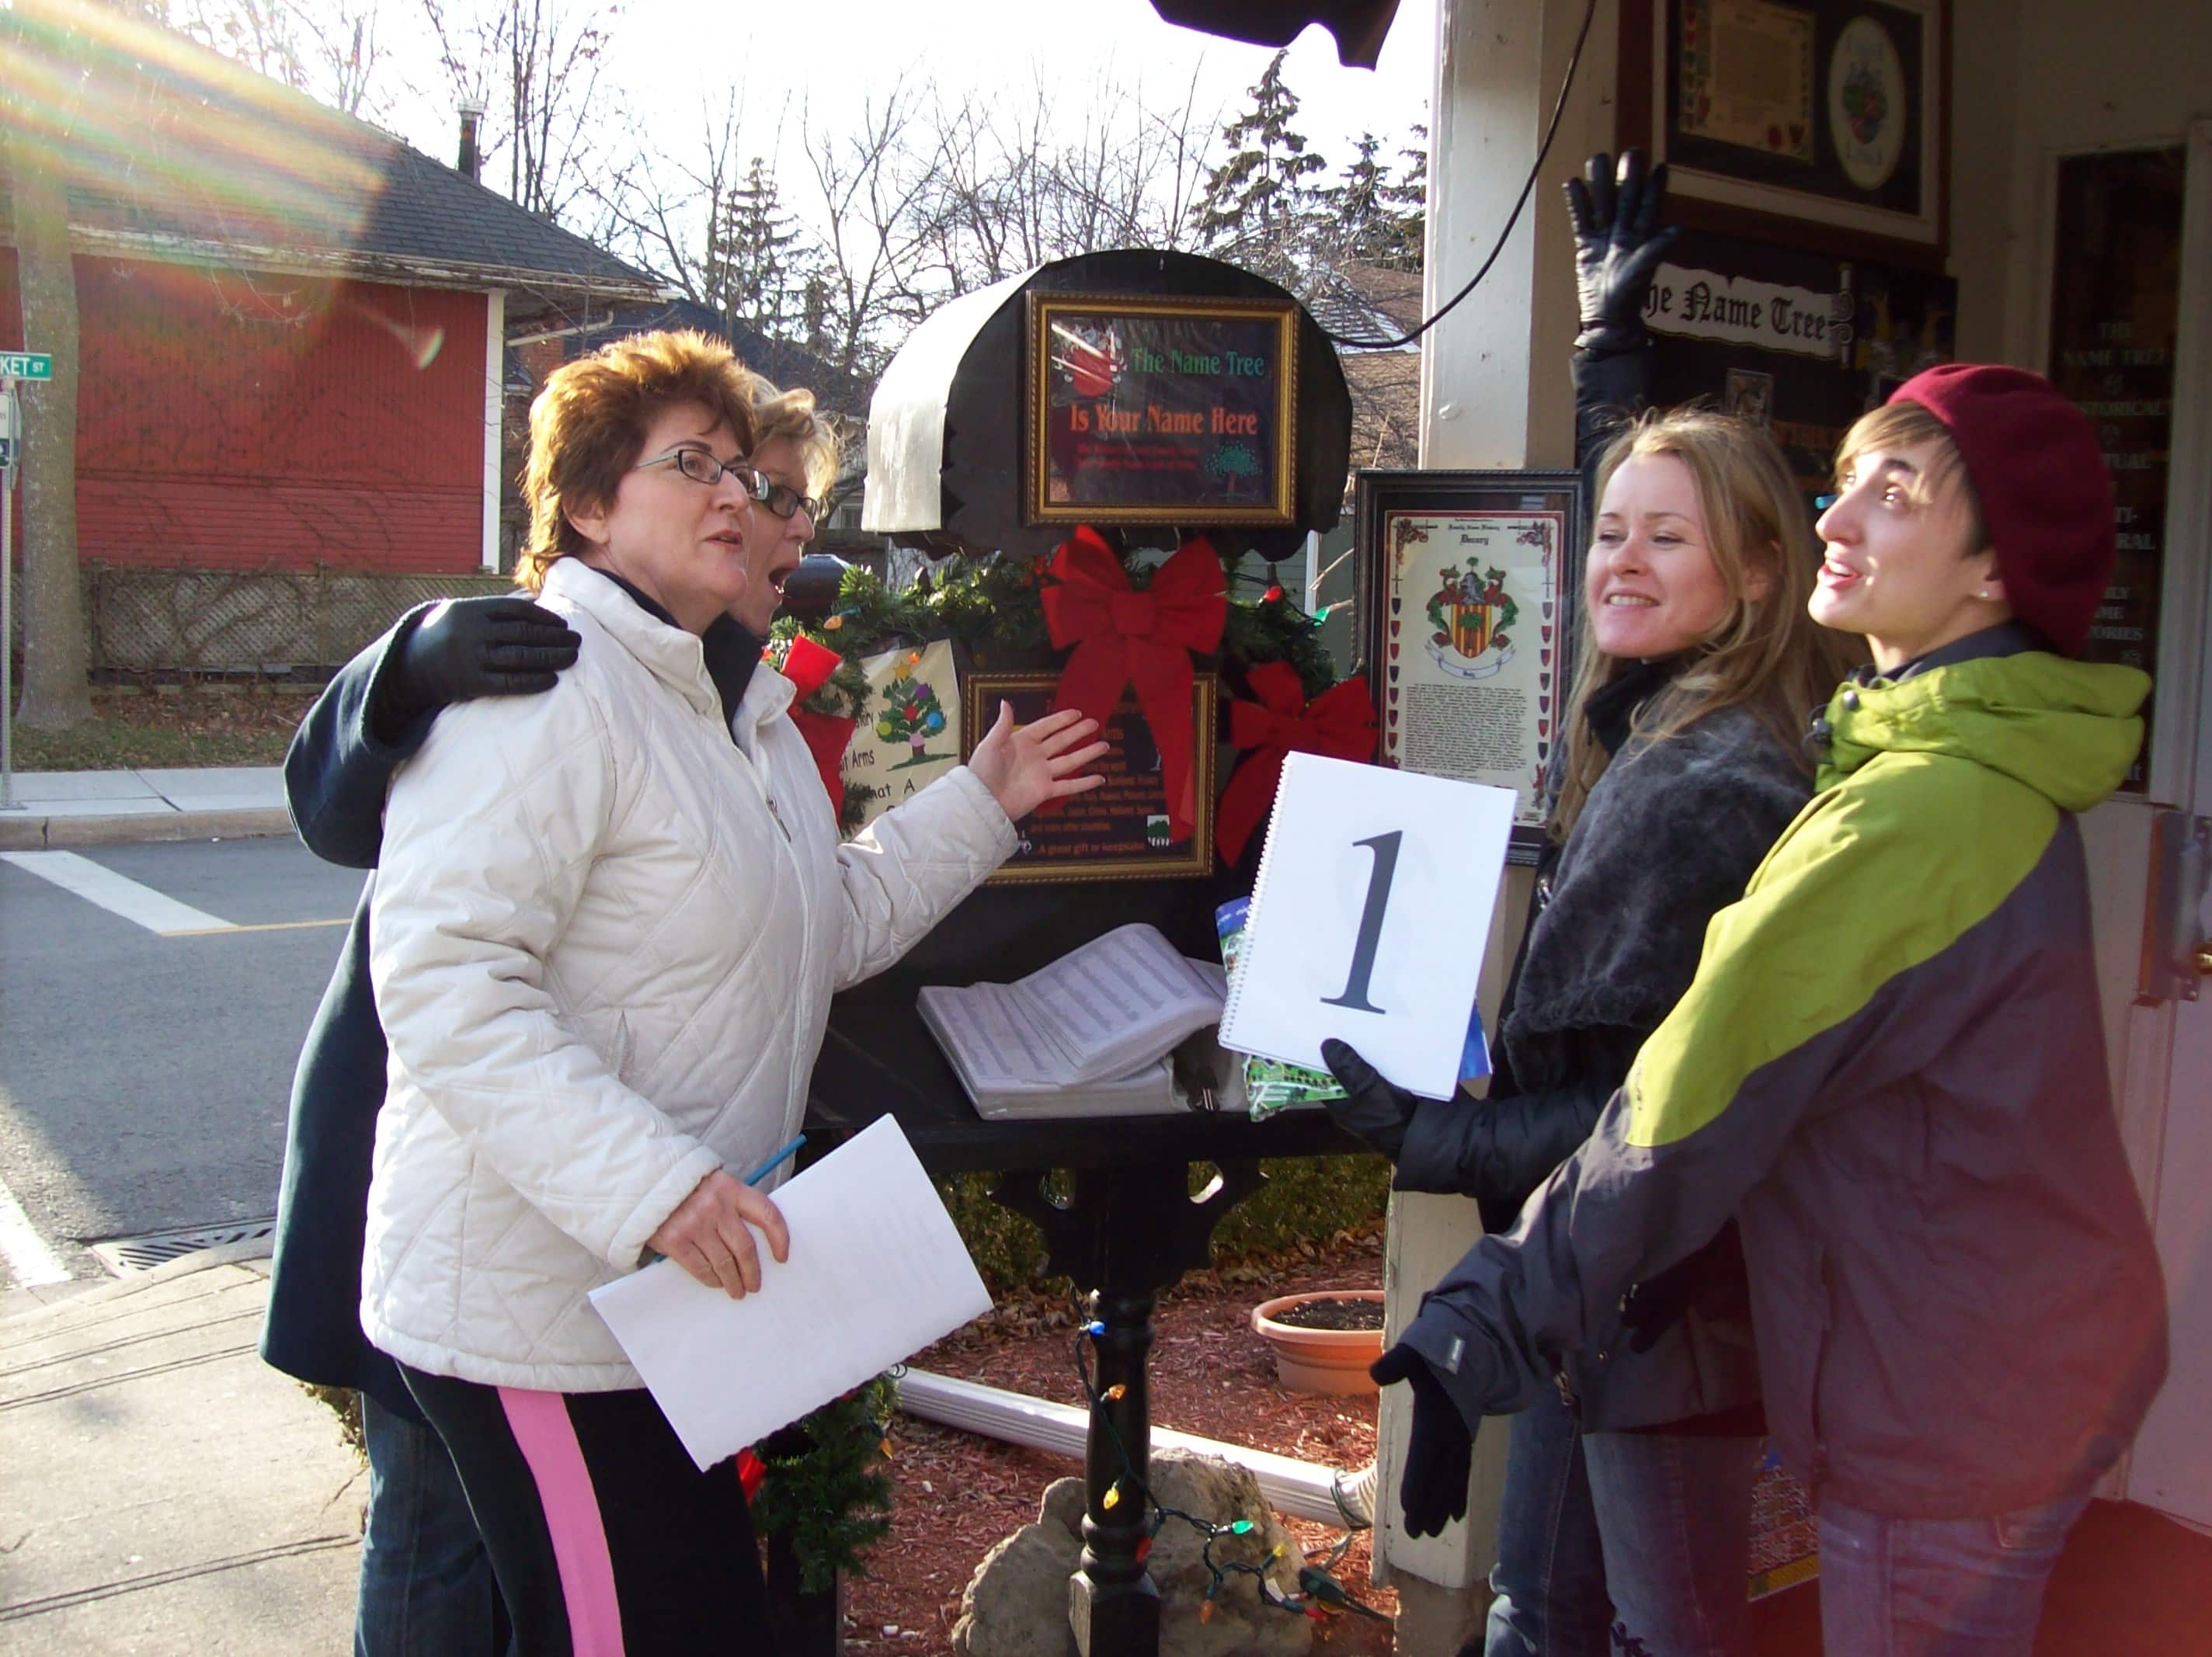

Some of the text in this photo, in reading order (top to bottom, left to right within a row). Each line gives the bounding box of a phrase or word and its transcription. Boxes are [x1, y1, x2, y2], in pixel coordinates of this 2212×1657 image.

[1679, 280, 1763, 330] Name
[1770, 296, 1829, 340] Tree
[33, 362, 44, 373] ST
[1132, 348, 1264, 377] The Name Tree
[1069, 402, 1257, 436] Is Your Name Here
[852, 748, 875, 768] Arms
[903, 777, 916, 795] A
[1320, 829, 1404, 1015] 1
